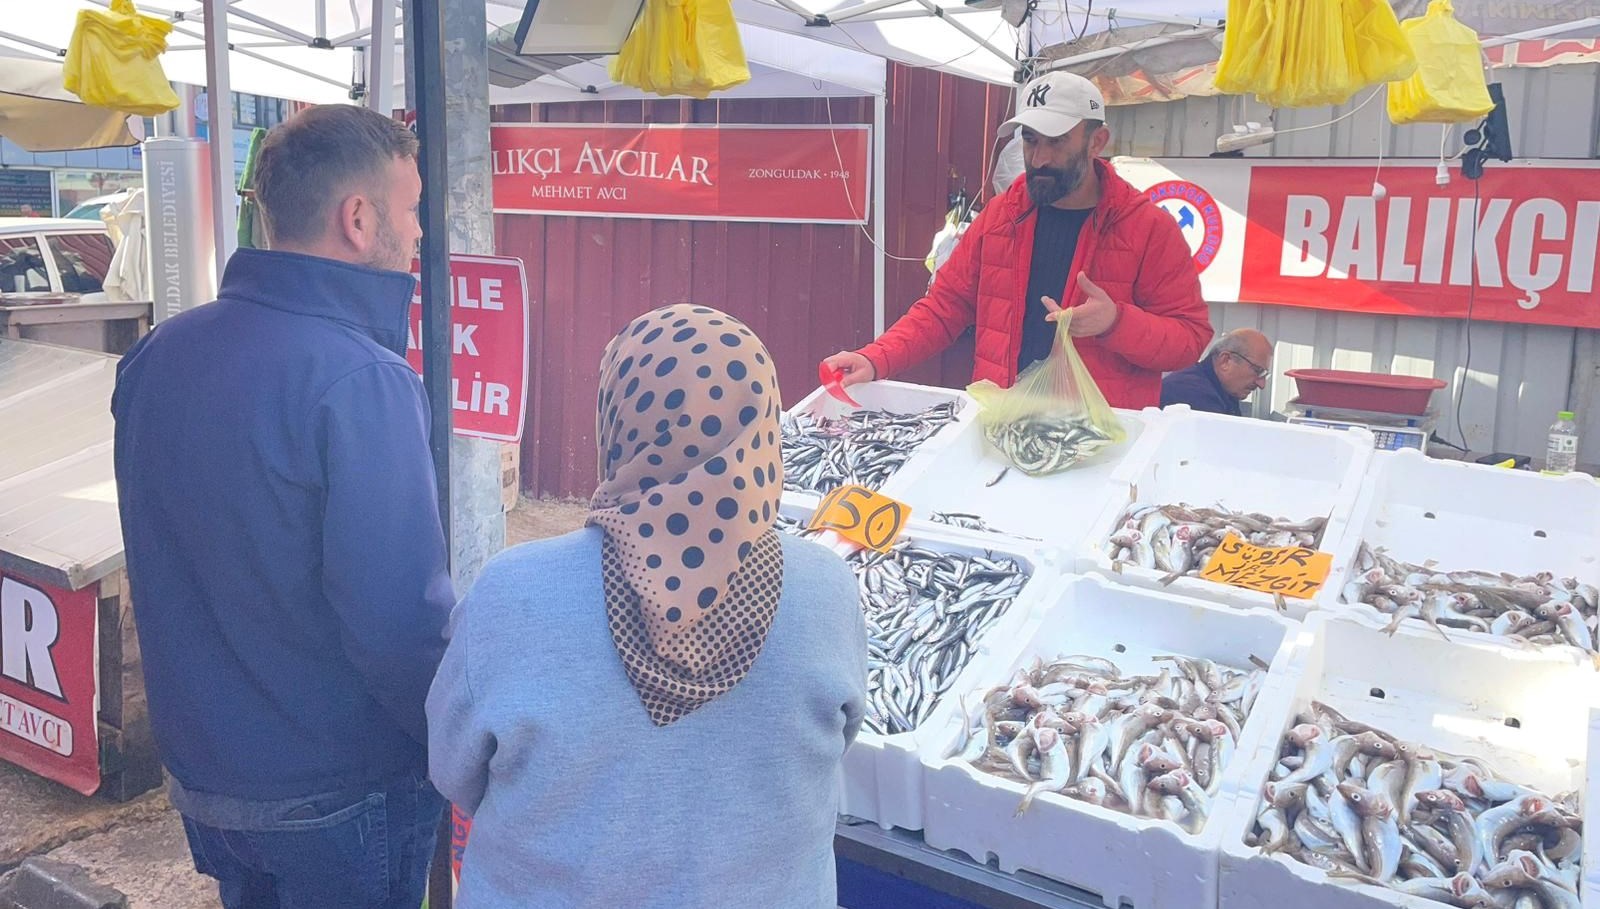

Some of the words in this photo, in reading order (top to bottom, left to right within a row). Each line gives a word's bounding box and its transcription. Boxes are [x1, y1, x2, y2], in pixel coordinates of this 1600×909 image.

[573, 142, 713, 185] AVCILAR
[748, 168, 821, 180] ZONGULDAK
[531, 185, 592, 199] MEHMET
[597, 187, 626, 200] AVCI
[1280, 194, 1600, 310] BALIKÇI
[1205, 563, 1320, 593] MEZGİT
[18, 710, 62, 747] AVCI
